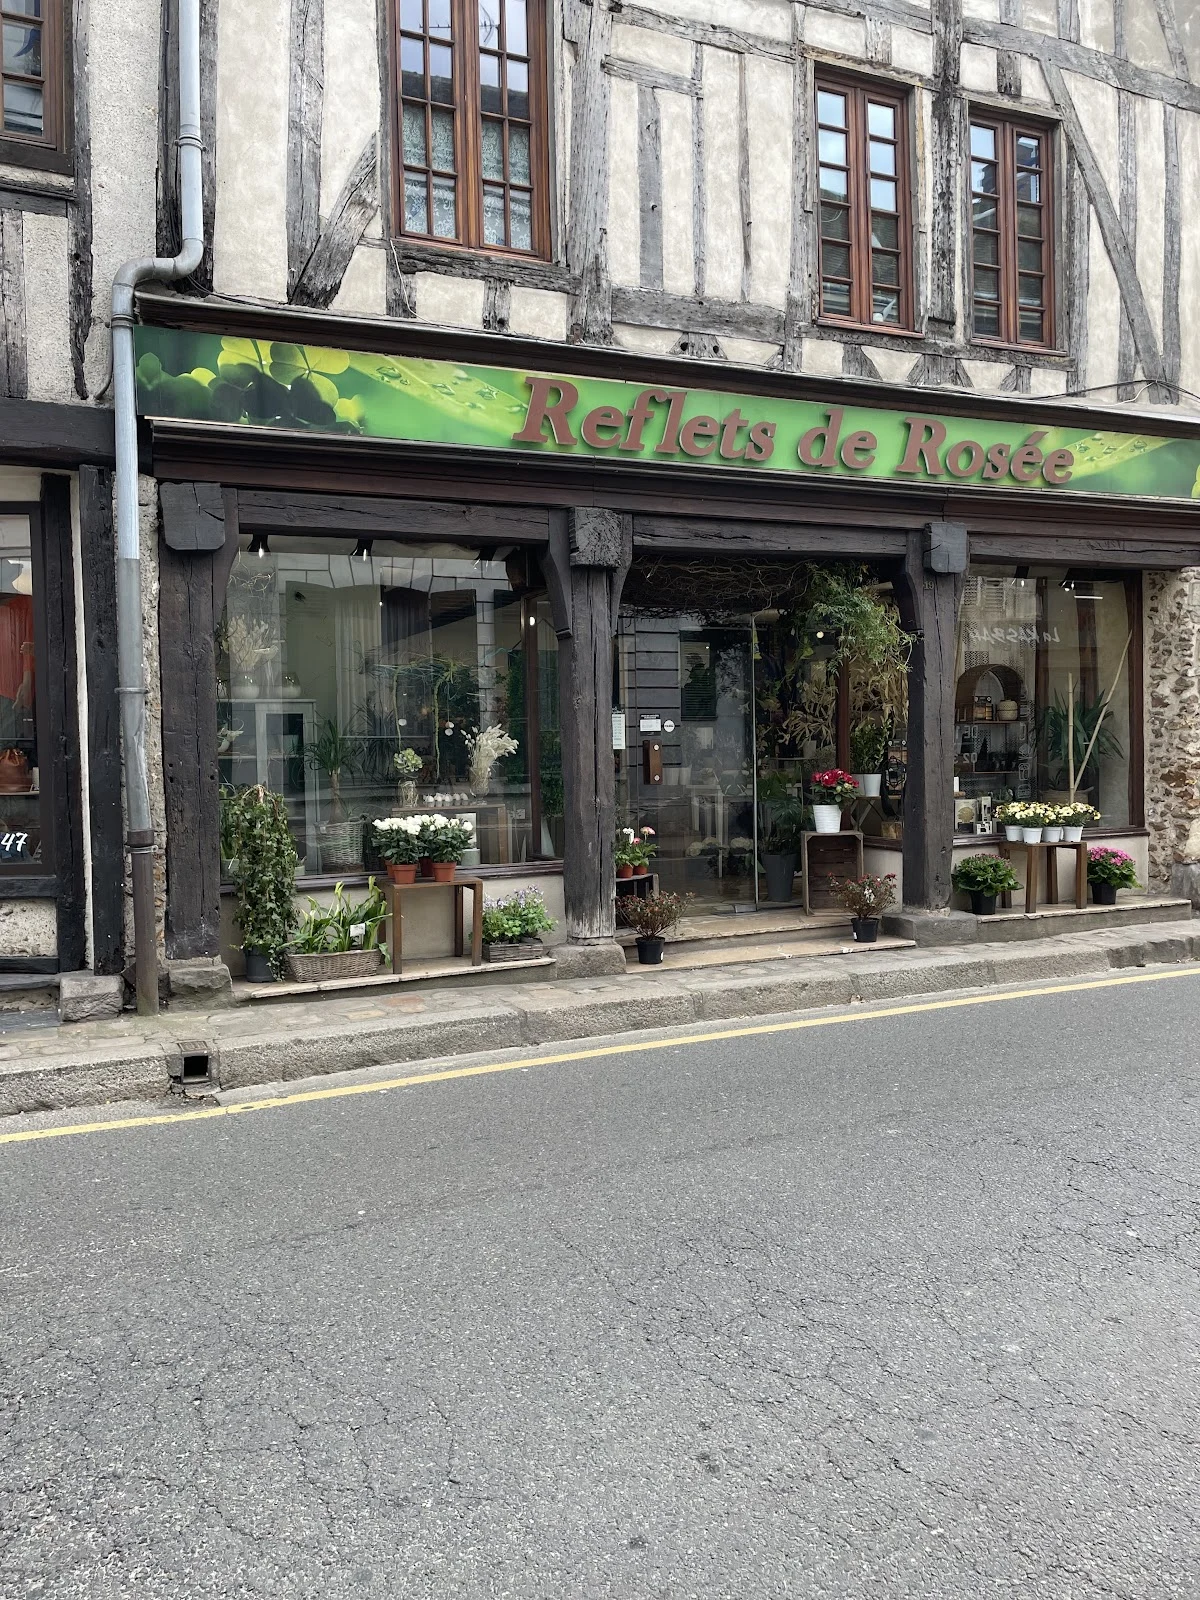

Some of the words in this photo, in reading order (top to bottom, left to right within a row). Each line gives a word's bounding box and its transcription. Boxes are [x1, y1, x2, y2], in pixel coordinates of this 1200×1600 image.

[511, 376, 777, 461] Reflets
[797, 407, 877, 469] de
[896, 417, 1074, 484] Rosée
[923, 580, 935, 590] 19
[0, 831, 29, 852] 47
